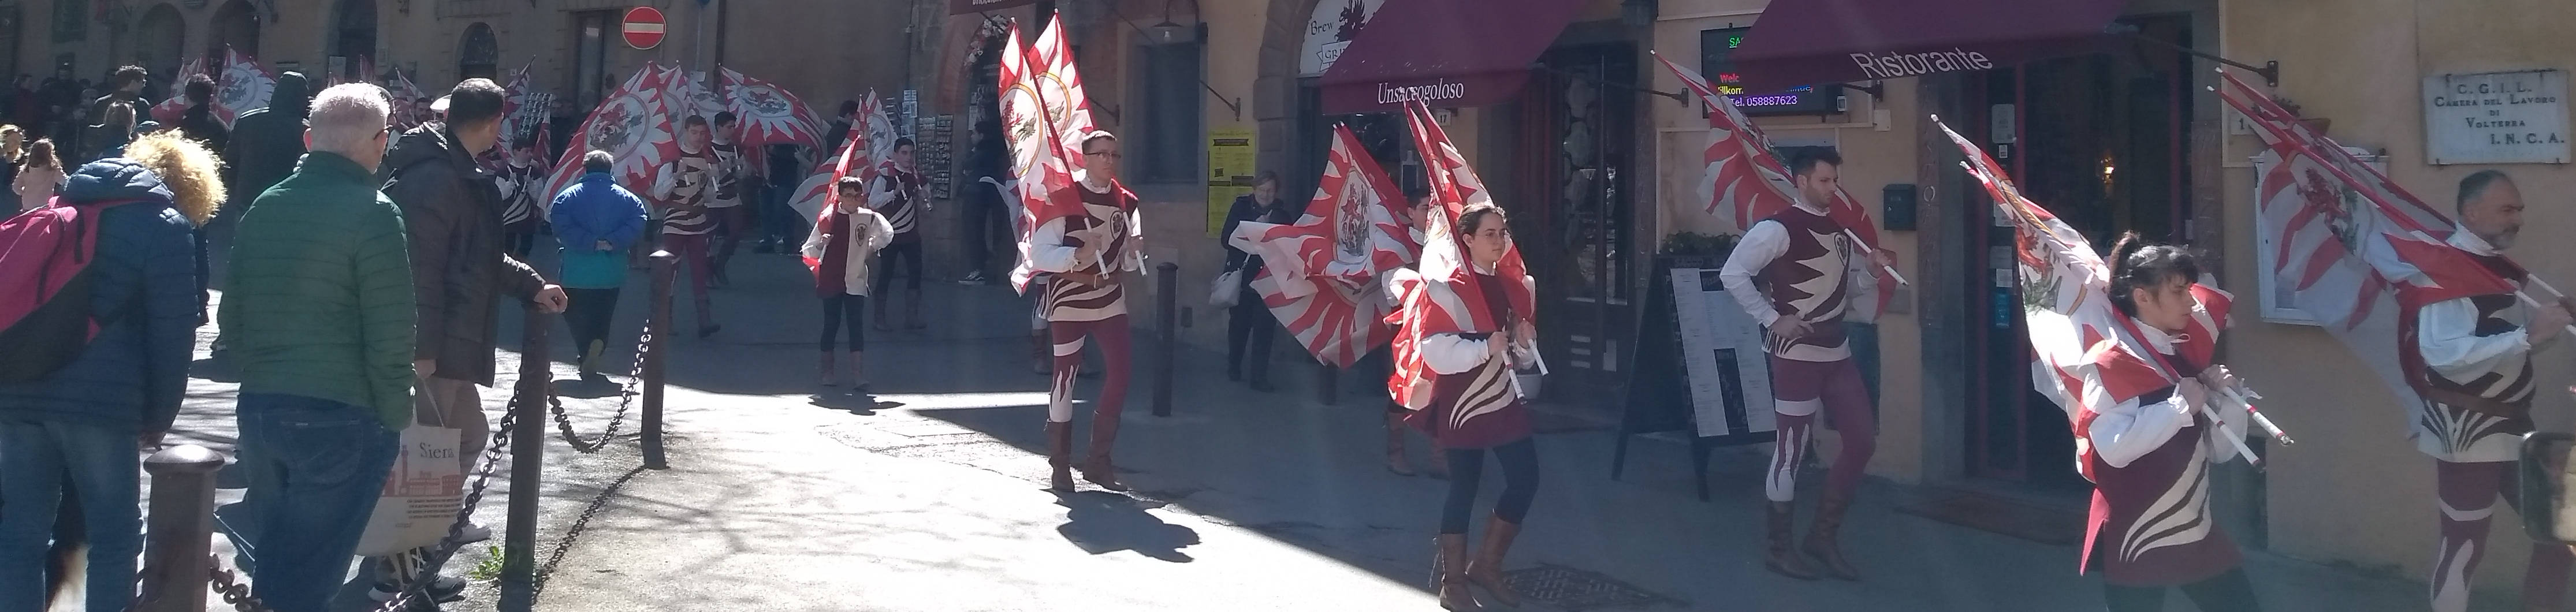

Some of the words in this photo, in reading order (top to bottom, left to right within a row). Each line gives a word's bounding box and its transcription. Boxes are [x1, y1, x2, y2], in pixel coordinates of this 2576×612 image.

[1311, 20, 1333, 35] Brew
[1850, 47, 1992, 79] Ristorante
[1747, 95, 1797, 106] 058887623
[1440, 114, 1447, 123] 17
